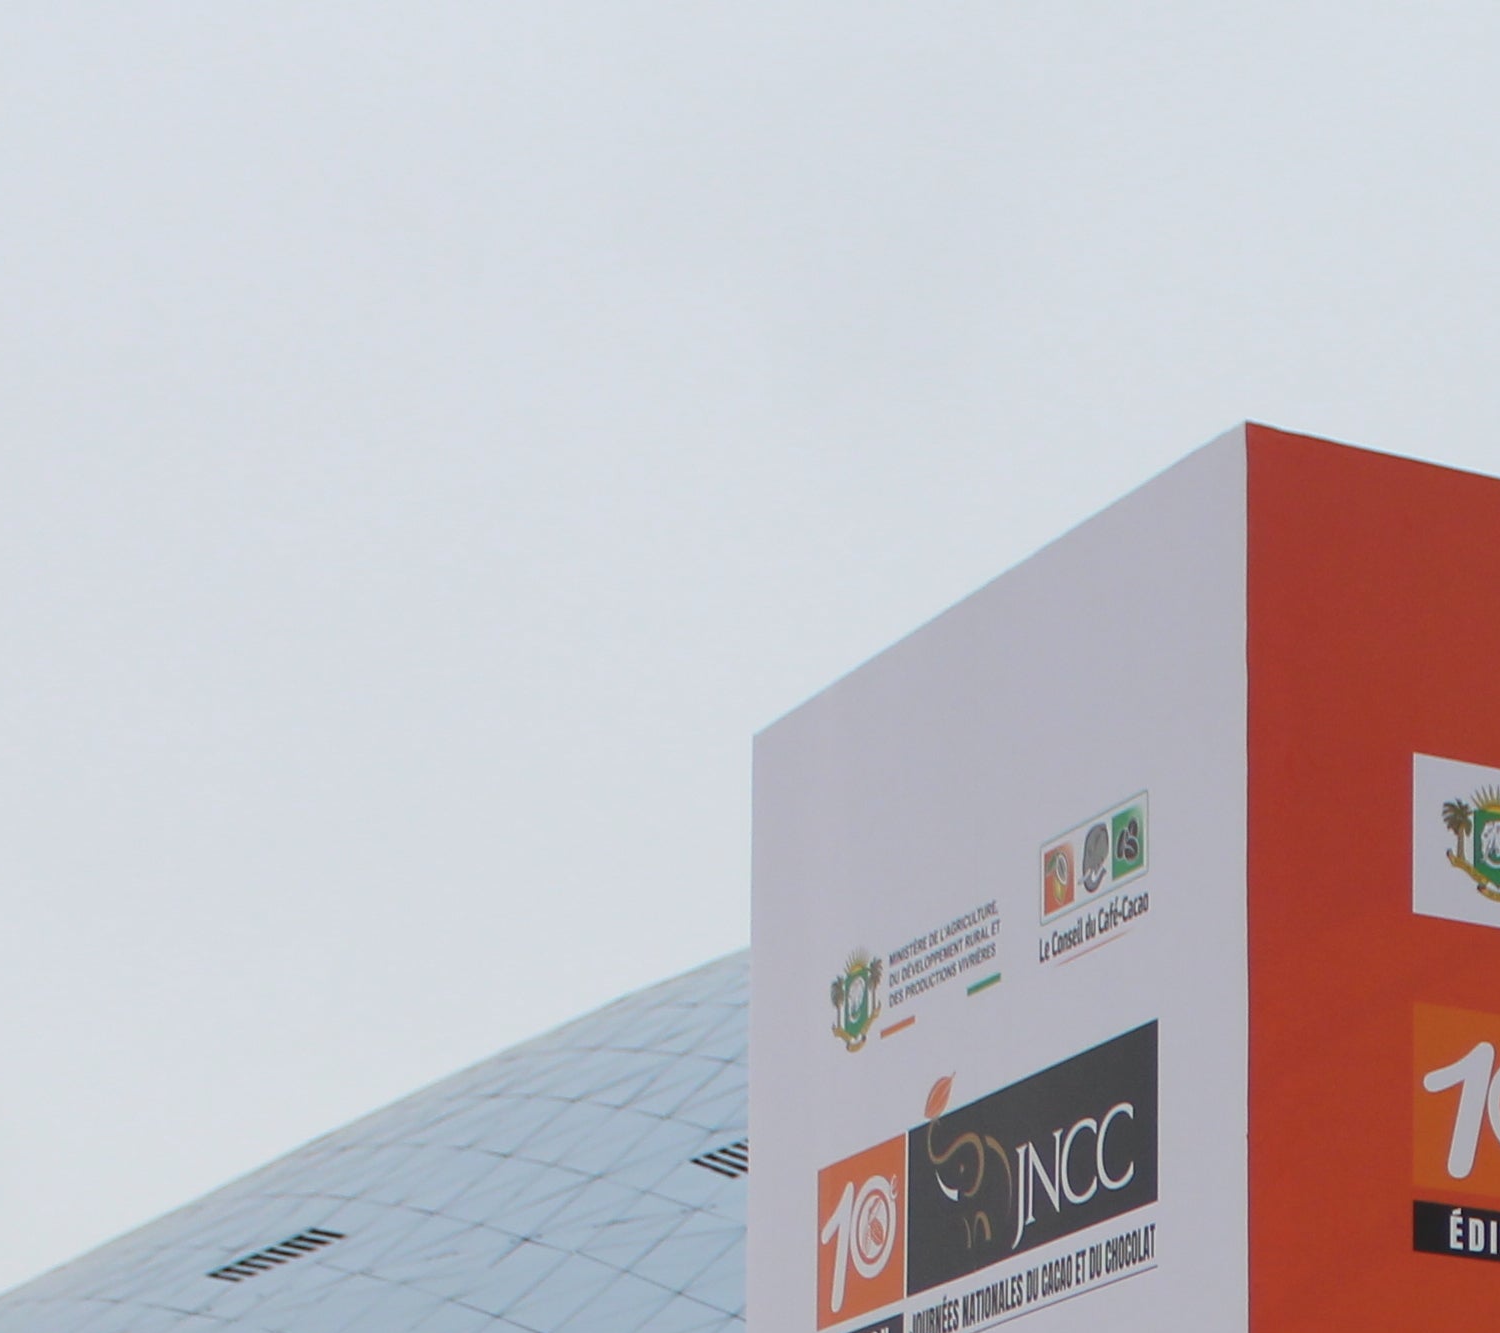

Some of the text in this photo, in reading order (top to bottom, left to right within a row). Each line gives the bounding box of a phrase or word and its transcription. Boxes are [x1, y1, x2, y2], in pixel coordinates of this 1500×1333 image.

[1039, 892, 1149, 964] Le Conseil du Café-Cacao
[1012, 1102, 1135, 1250] JNCC
[962, 1275, 1024, 1328] NATIONALES
[1026, 1267, 1039, 1303] DU
[1041, 1250, 1074, 1297] CACAO
[1075, 1247, 1087, 1285] ET
[1089, 1243, 1103, 1279] DU
[1105, 1223, 1157, 1274] CHOCOLAT
